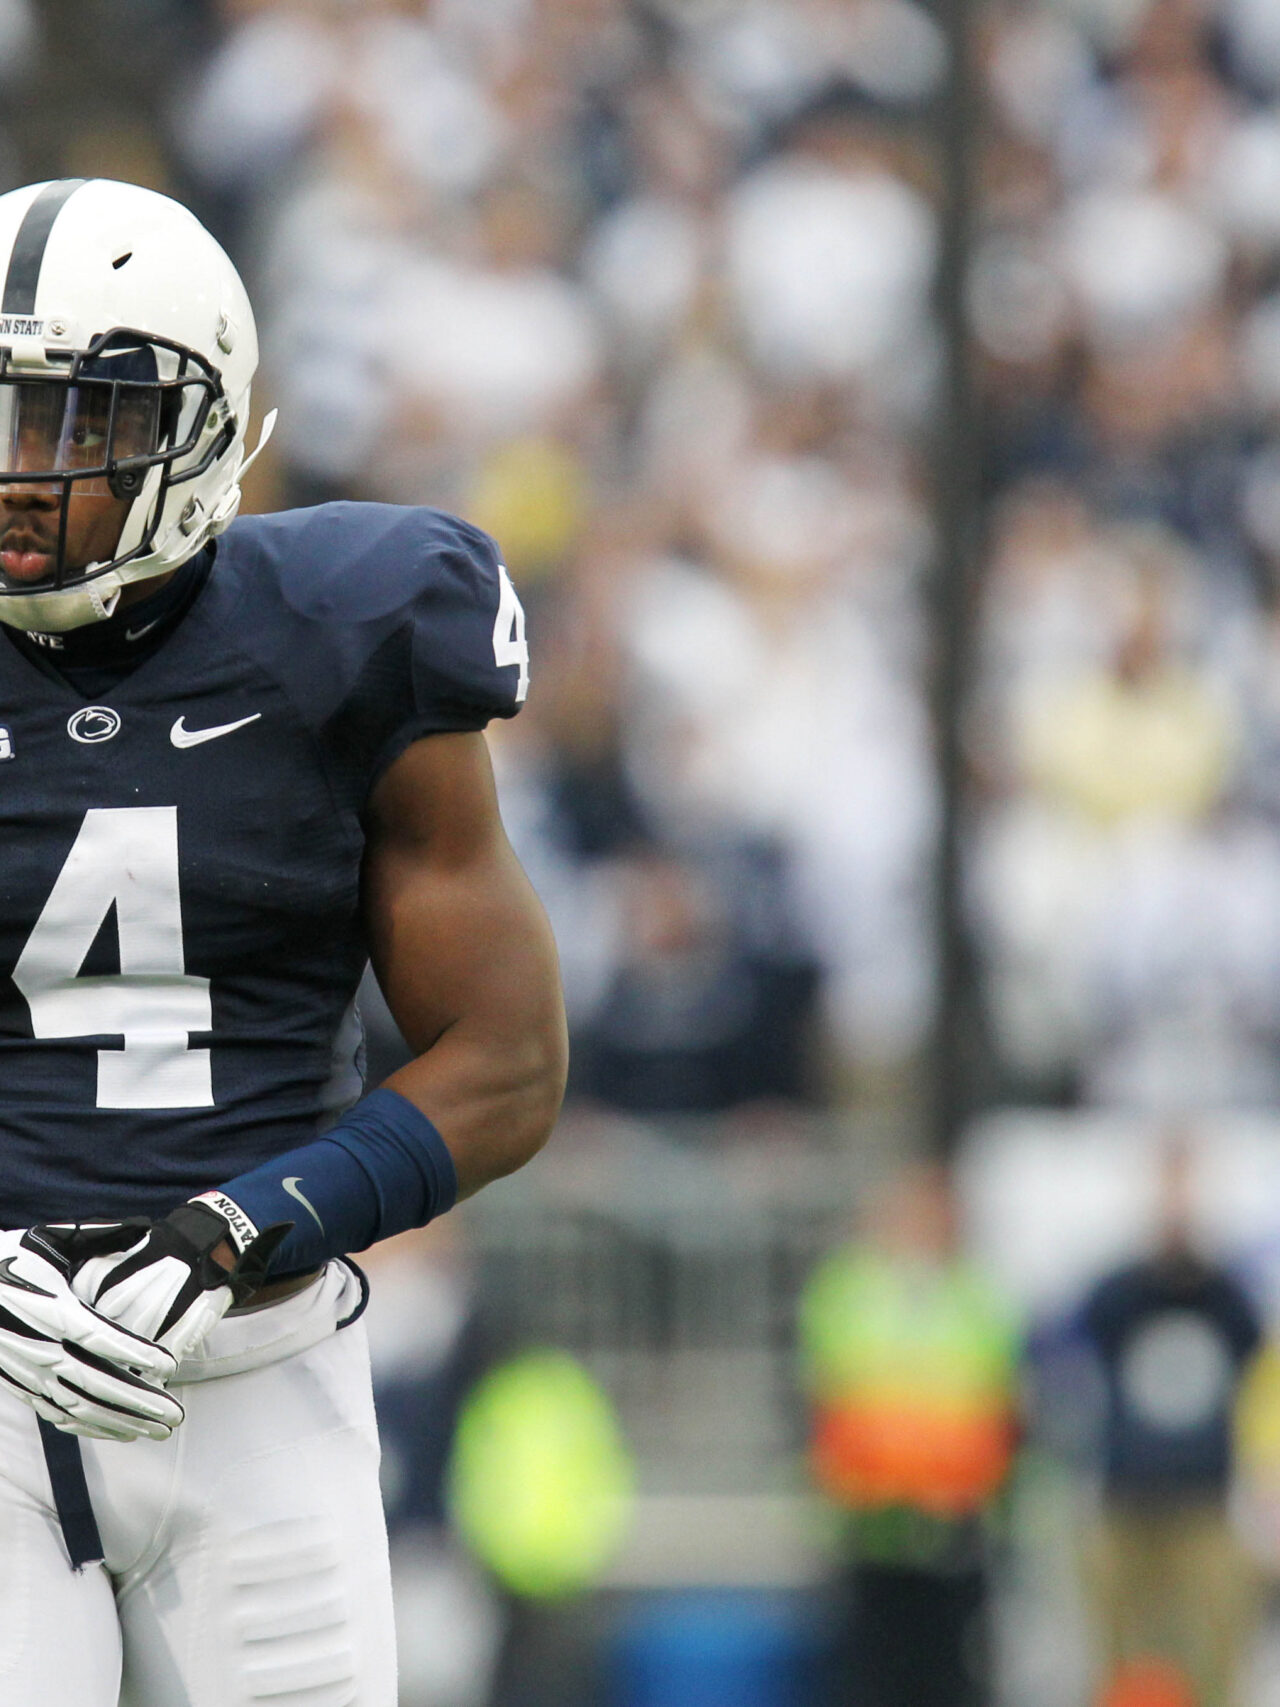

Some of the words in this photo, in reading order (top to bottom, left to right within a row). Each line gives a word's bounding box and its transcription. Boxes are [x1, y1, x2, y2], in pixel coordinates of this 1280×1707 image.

[492, 565, 530, 702] 4
[11, 806, 215, 1107] 4
[214, 1197, 255, 1246] ATION
